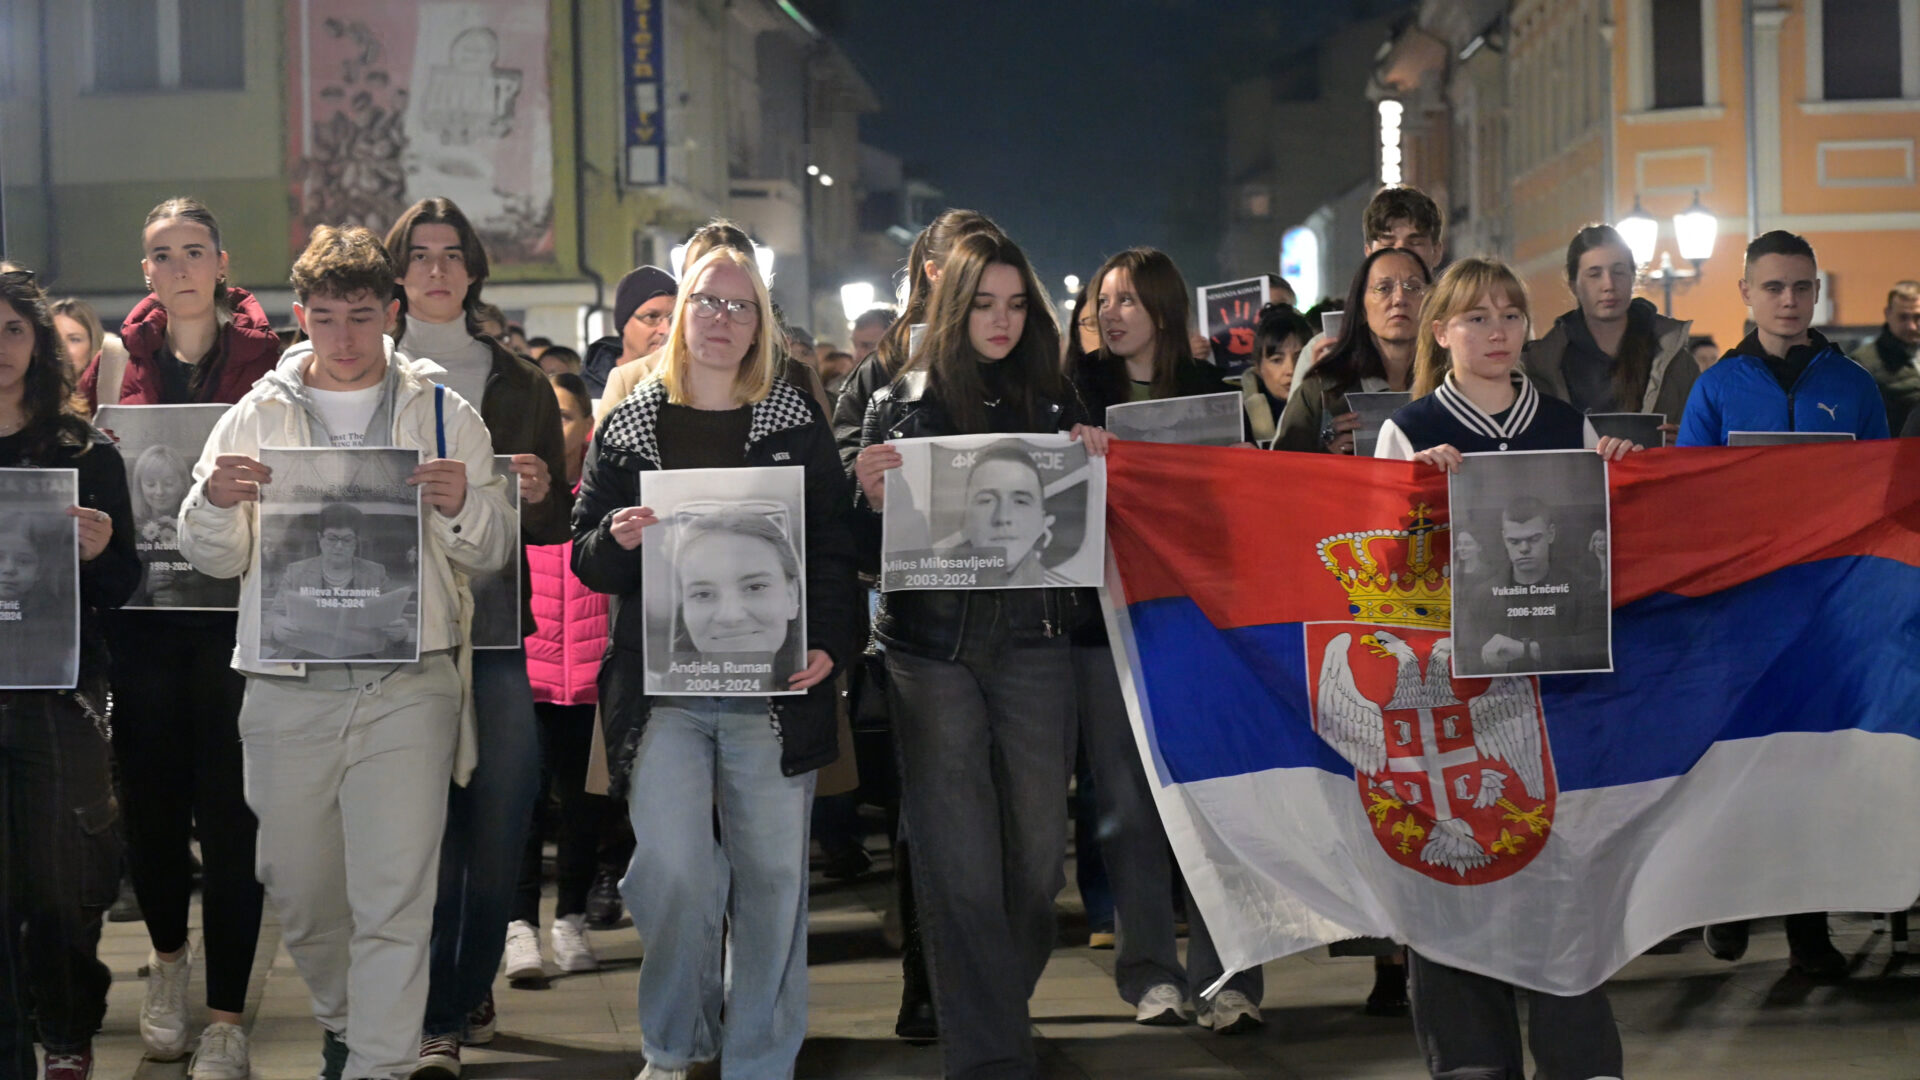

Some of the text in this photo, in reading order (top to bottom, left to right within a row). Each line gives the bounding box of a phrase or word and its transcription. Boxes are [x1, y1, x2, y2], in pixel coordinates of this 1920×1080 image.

[885, 555, 1005, 573] Milos Milosavljevic
[905, 573, 977, 587] 2003-2024
[300, 586, 380, 598] Mileva Karanović
[1492, 583, 1569, 596] Vukašin Crnčević
[669, 661, 772, 676] Andjela Ruman
[685, 679, 761, 692] 2004-2024
